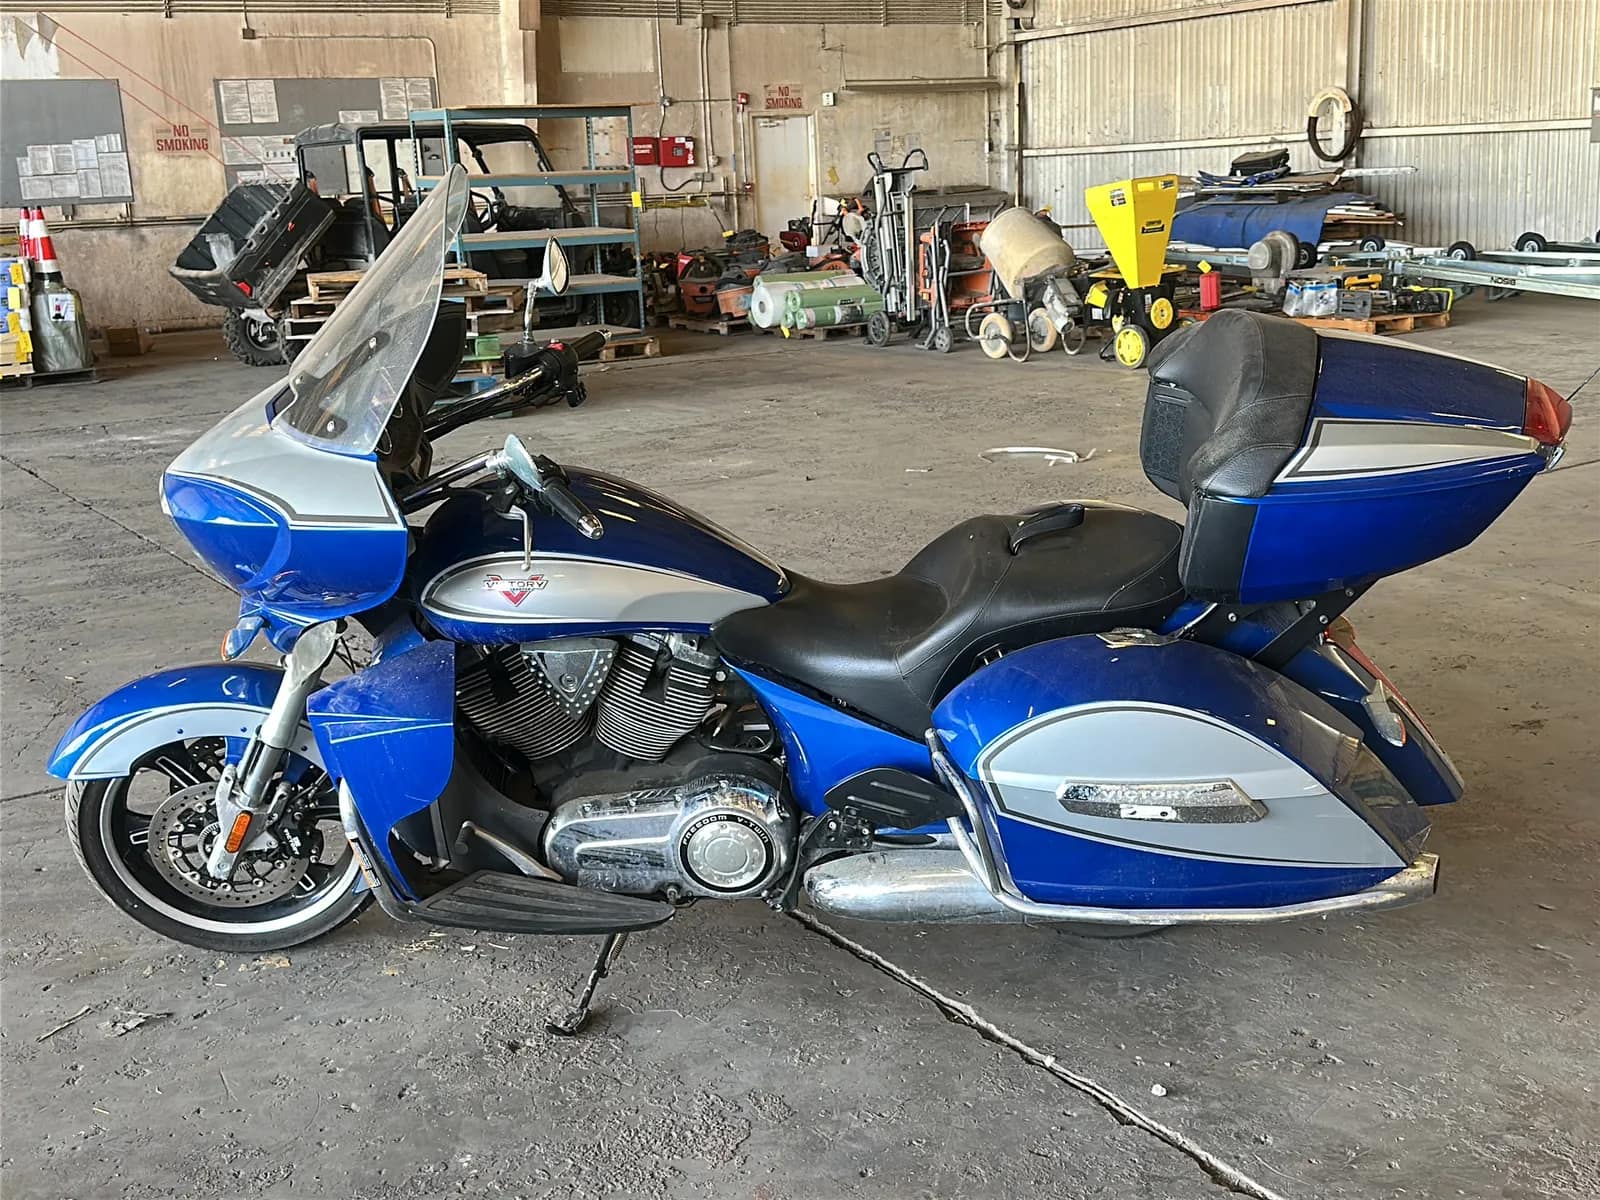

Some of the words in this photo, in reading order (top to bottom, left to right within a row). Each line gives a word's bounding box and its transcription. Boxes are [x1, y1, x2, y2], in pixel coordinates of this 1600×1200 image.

[777, 86, 790, 97] NO
[766, 97, 802, 109] SMOKING
[173, 125, 189, 137] NO
[156, 138, 209, 151] SMOKING
[1101, 789, 1196, 799] VICTORY
